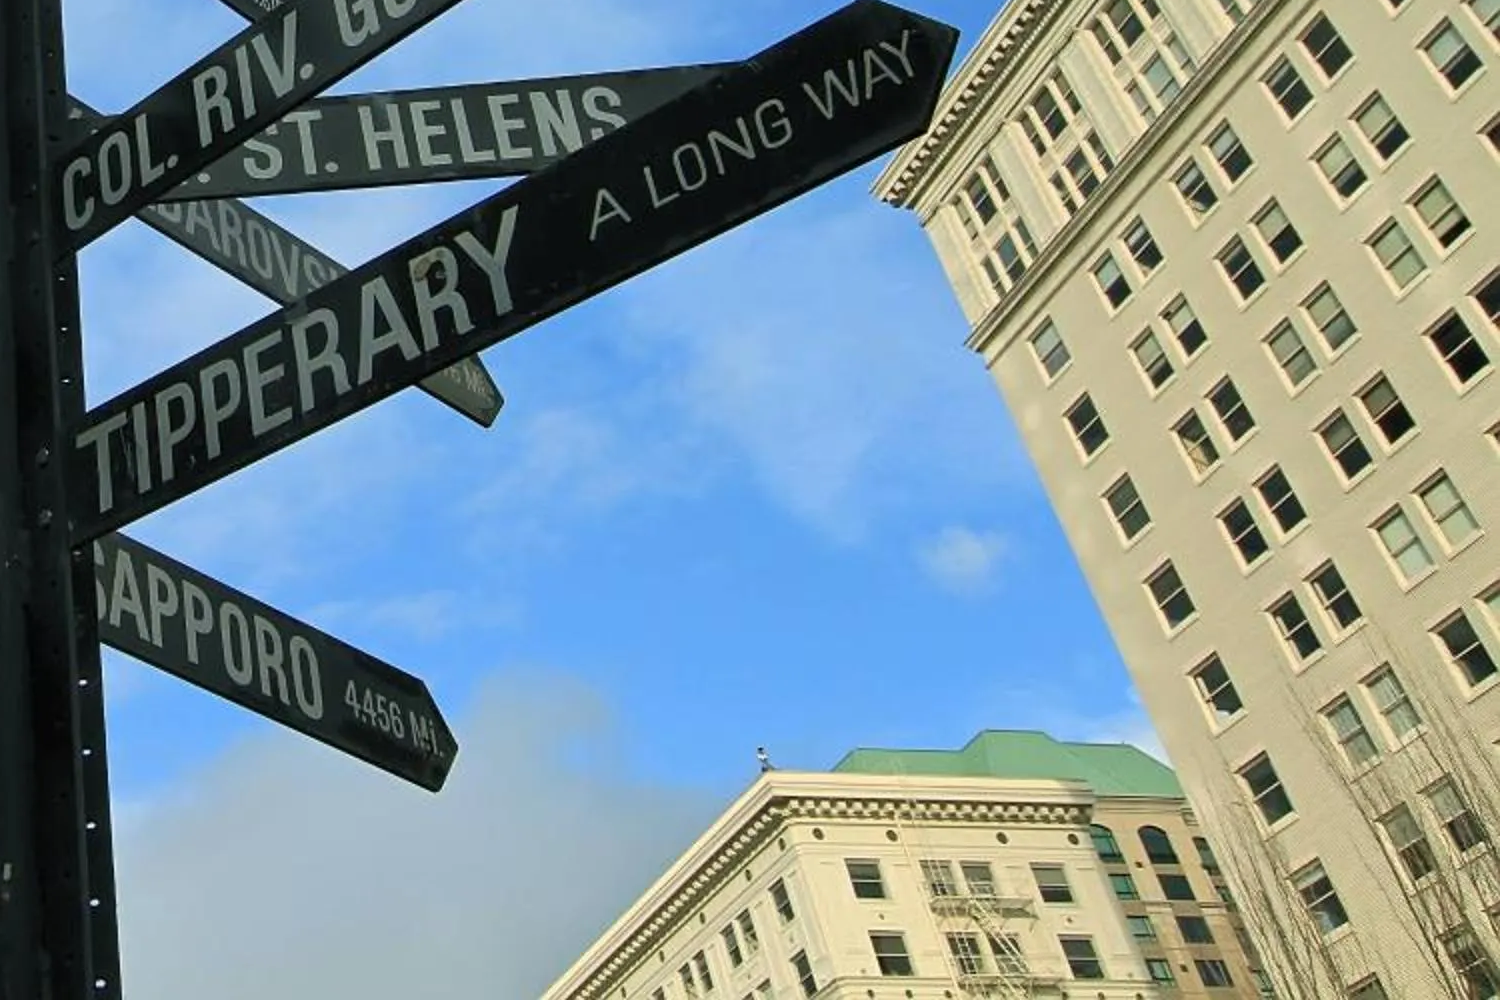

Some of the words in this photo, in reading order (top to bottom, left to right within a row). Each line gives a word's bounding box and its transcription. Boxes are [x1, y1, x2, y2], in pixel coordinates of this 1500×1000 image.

[63, 113, 179, 230] COL.
[193, 8, 314, 148] RIV.
[243, 109, 339, 179] ST.
[358, 87, 627, 170] HELENS
[75, 204, 519, 514] TIPPERARY
[589, 188, 632, 241] A
[643, 98, 793, 209] LONG
[802, 29, 915, 120] WAY
